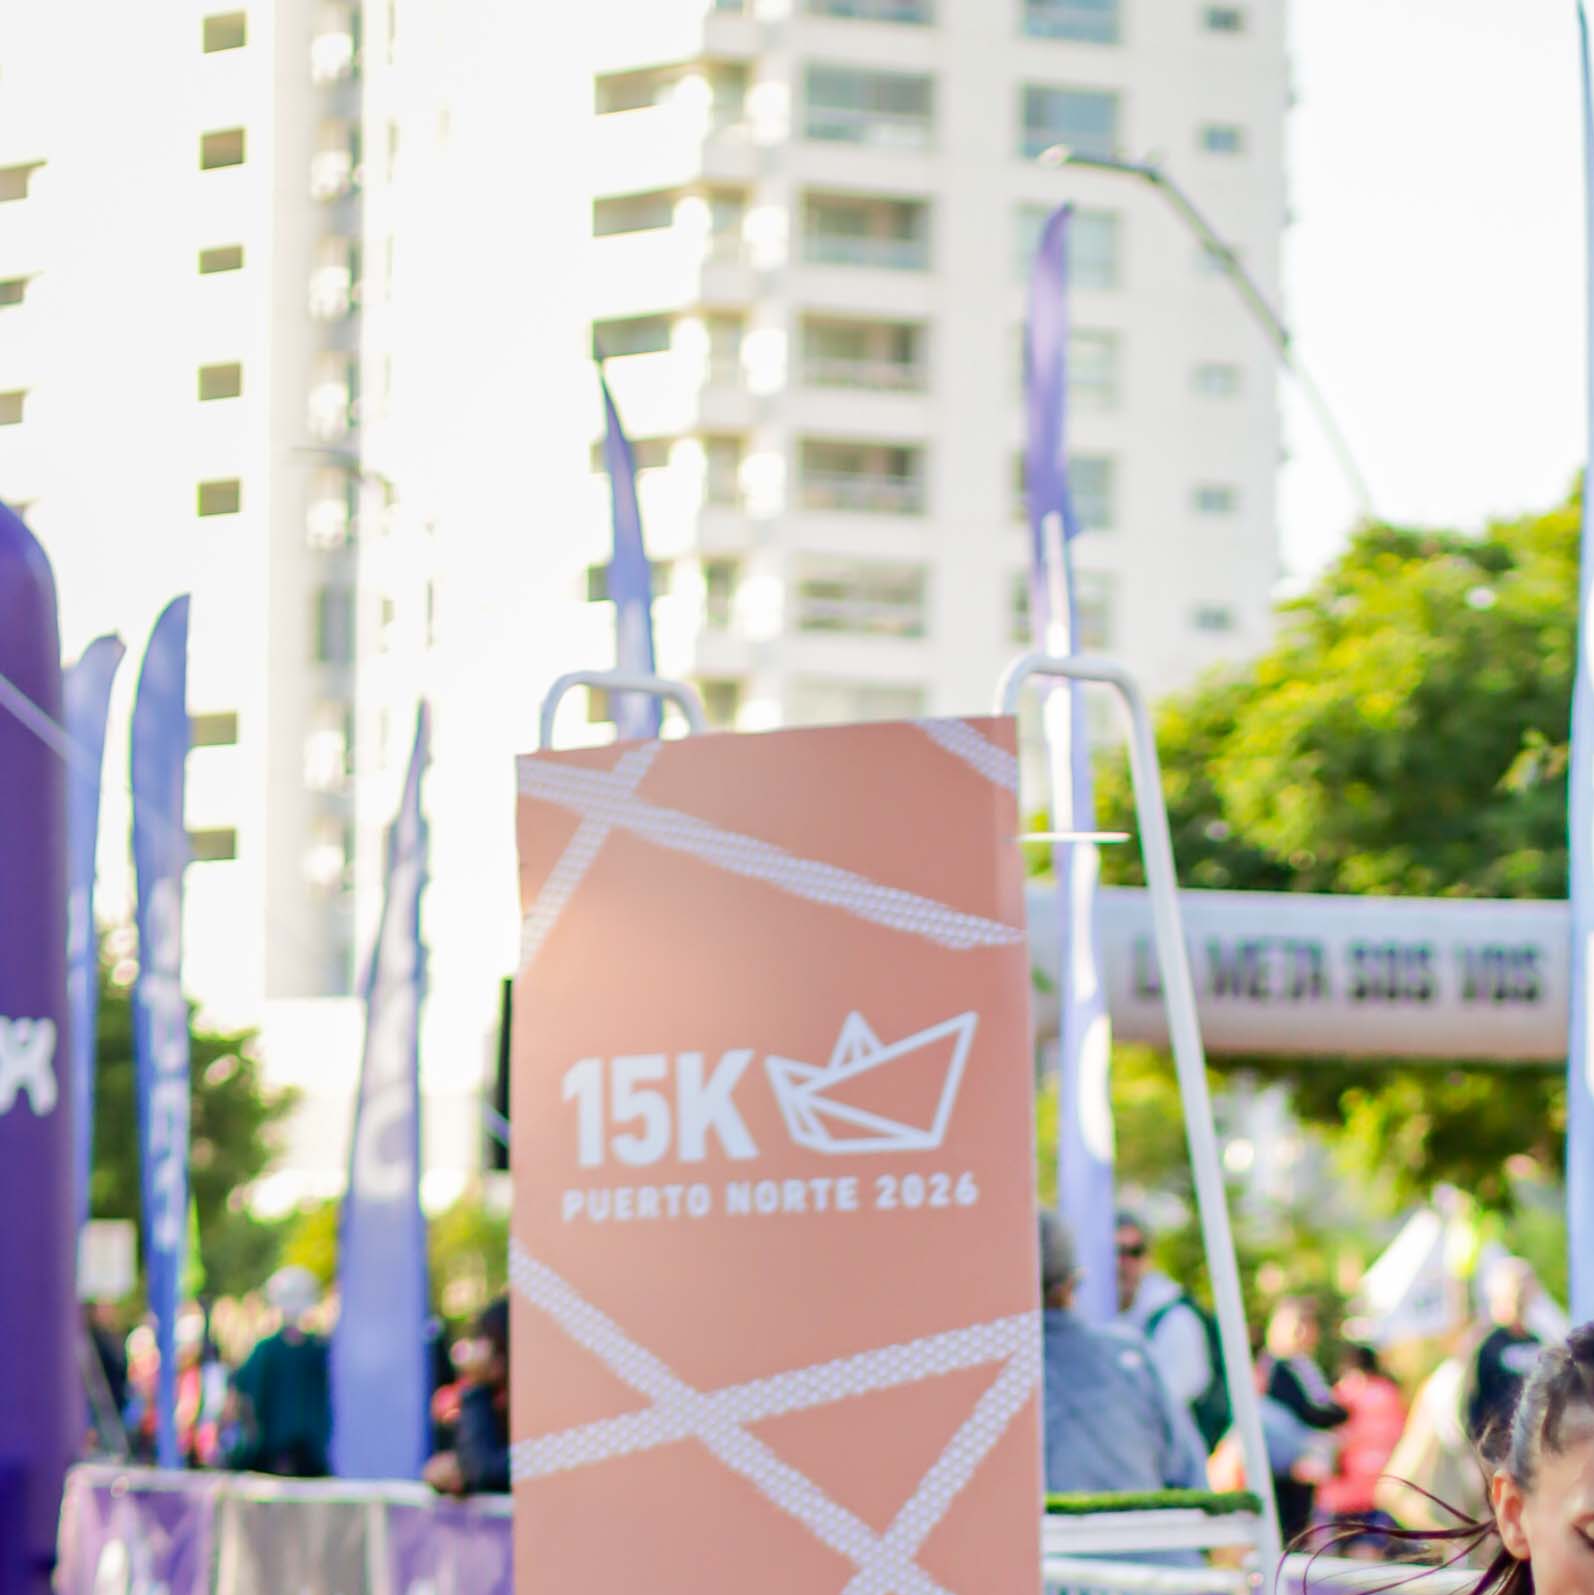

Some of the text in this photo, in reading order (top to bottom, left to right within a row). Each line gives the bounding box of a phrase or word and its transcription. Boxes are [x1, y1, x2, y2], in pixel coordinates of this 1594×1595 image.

[562, 1049, 760, 1168] 15K
[563, 1171, 979, 1223] PUERTO NORTE 2026
